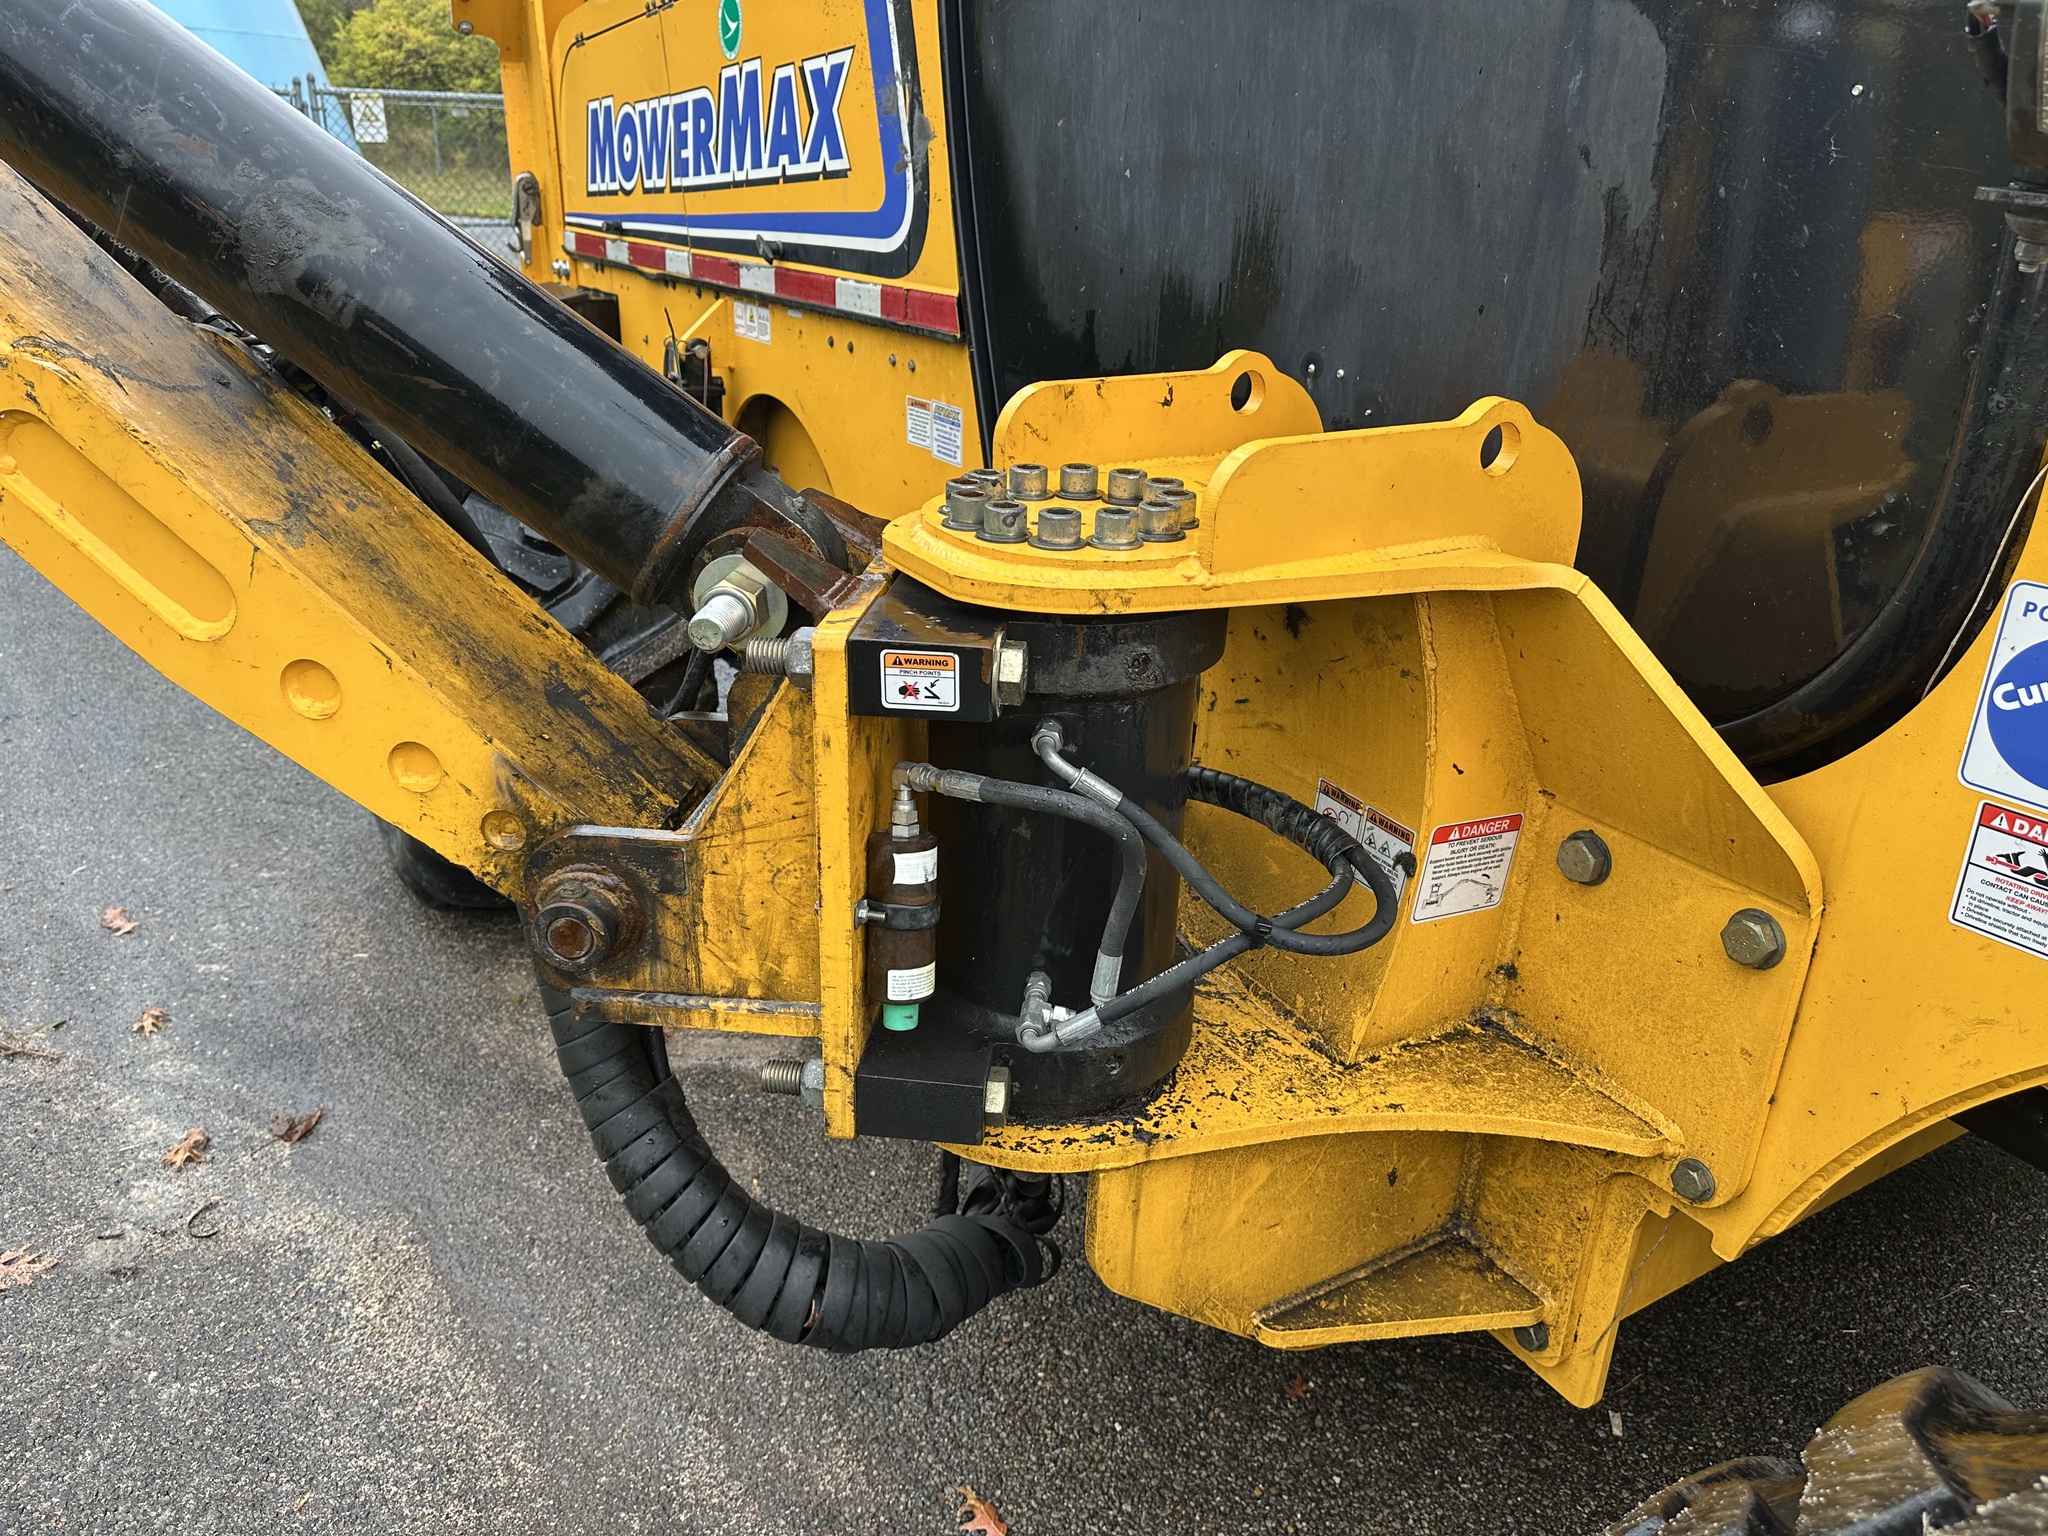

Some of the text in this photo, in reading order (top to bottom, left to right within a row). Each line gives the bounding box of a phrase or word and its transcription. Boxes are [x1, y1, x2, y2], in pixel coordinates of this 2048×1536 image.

[903, 657, 949, 667] WARNING
[1331, 788, 1360, 812] WARNING
[1379, 818, 1410, 842] WARNING
[1461, 819, 1510, 838] DANGER
[1449, 847, 1468, 856] INJURY
[1477, 842, 1496, 850] DEATH:
[1455, 838, 1480, 848] PREVENT
[1479, 834, 1503, 843] SERIOUS
[1980, 879, 2013, 894] CONTACT
[2013, 890, 2029, 900] CAN
[1995, 877, 2029, 893] ROTATING
[1974, 903, 1989, 913] place
[1976, 898, 2001, 911] driveline,
[2002, 908, 2020, 918] tractor
[1985, 895, 2007, 906] operate
[2007, 903, 2028, 913] without
[2005, 895, 2025, 906] KEEP
[1964, 912, 2048, 948] Driveline shields that turn freely
[1965, 906, 1992, 920] Drivelines
[1992, 916, 2016, 929] securely
[2016, 926, 2041, 938] attached
